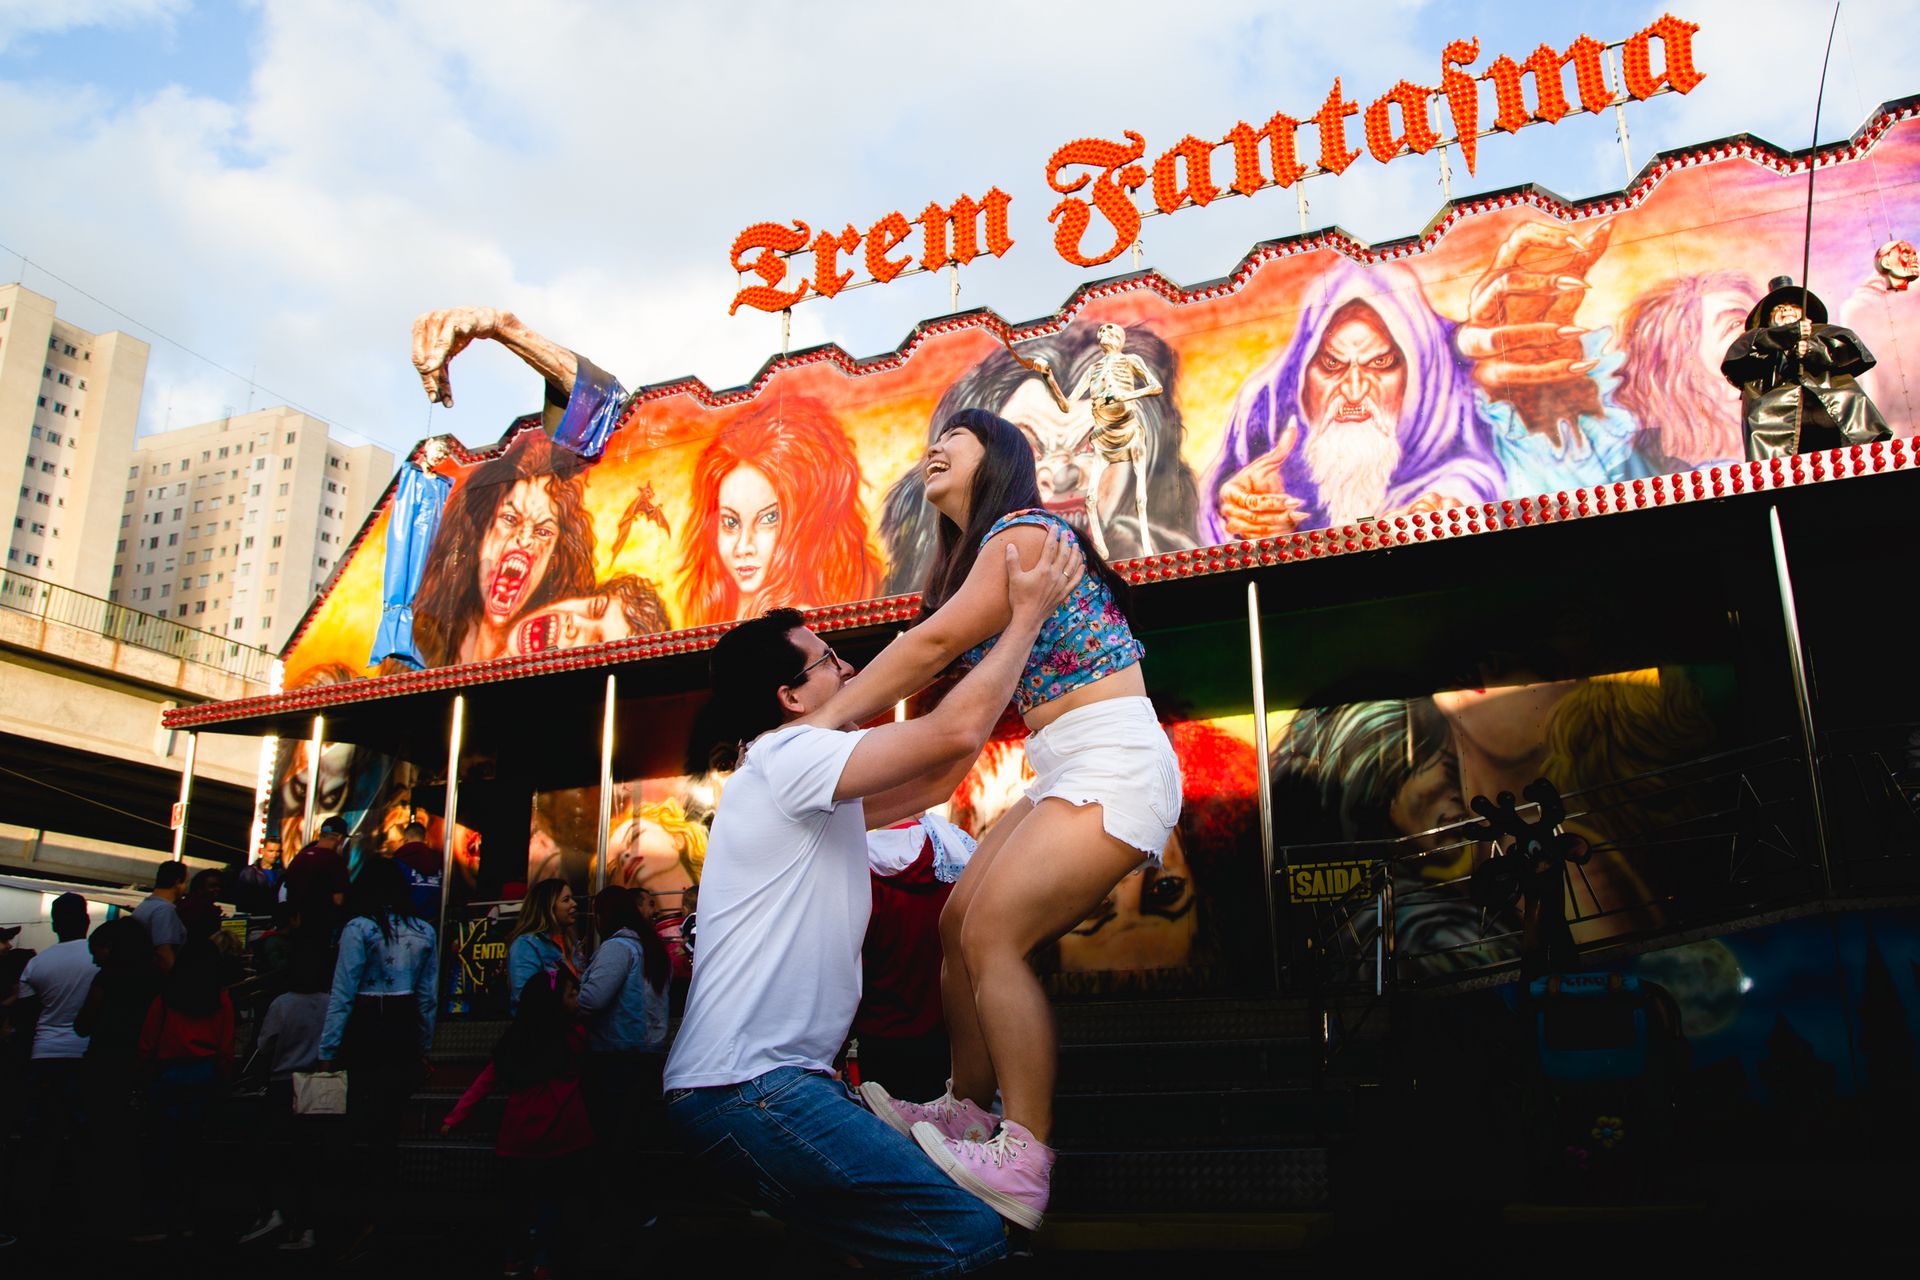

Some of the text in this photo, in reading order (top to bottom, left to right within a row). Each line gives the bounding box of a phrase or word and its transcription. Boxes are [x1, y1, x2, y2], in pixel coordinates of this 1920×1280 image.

[729, 12, 1706, 316] Trem Fantasma
[1296, 867, 1361, 896] SAIDA
[473, 942, 507, 960] ENTR
